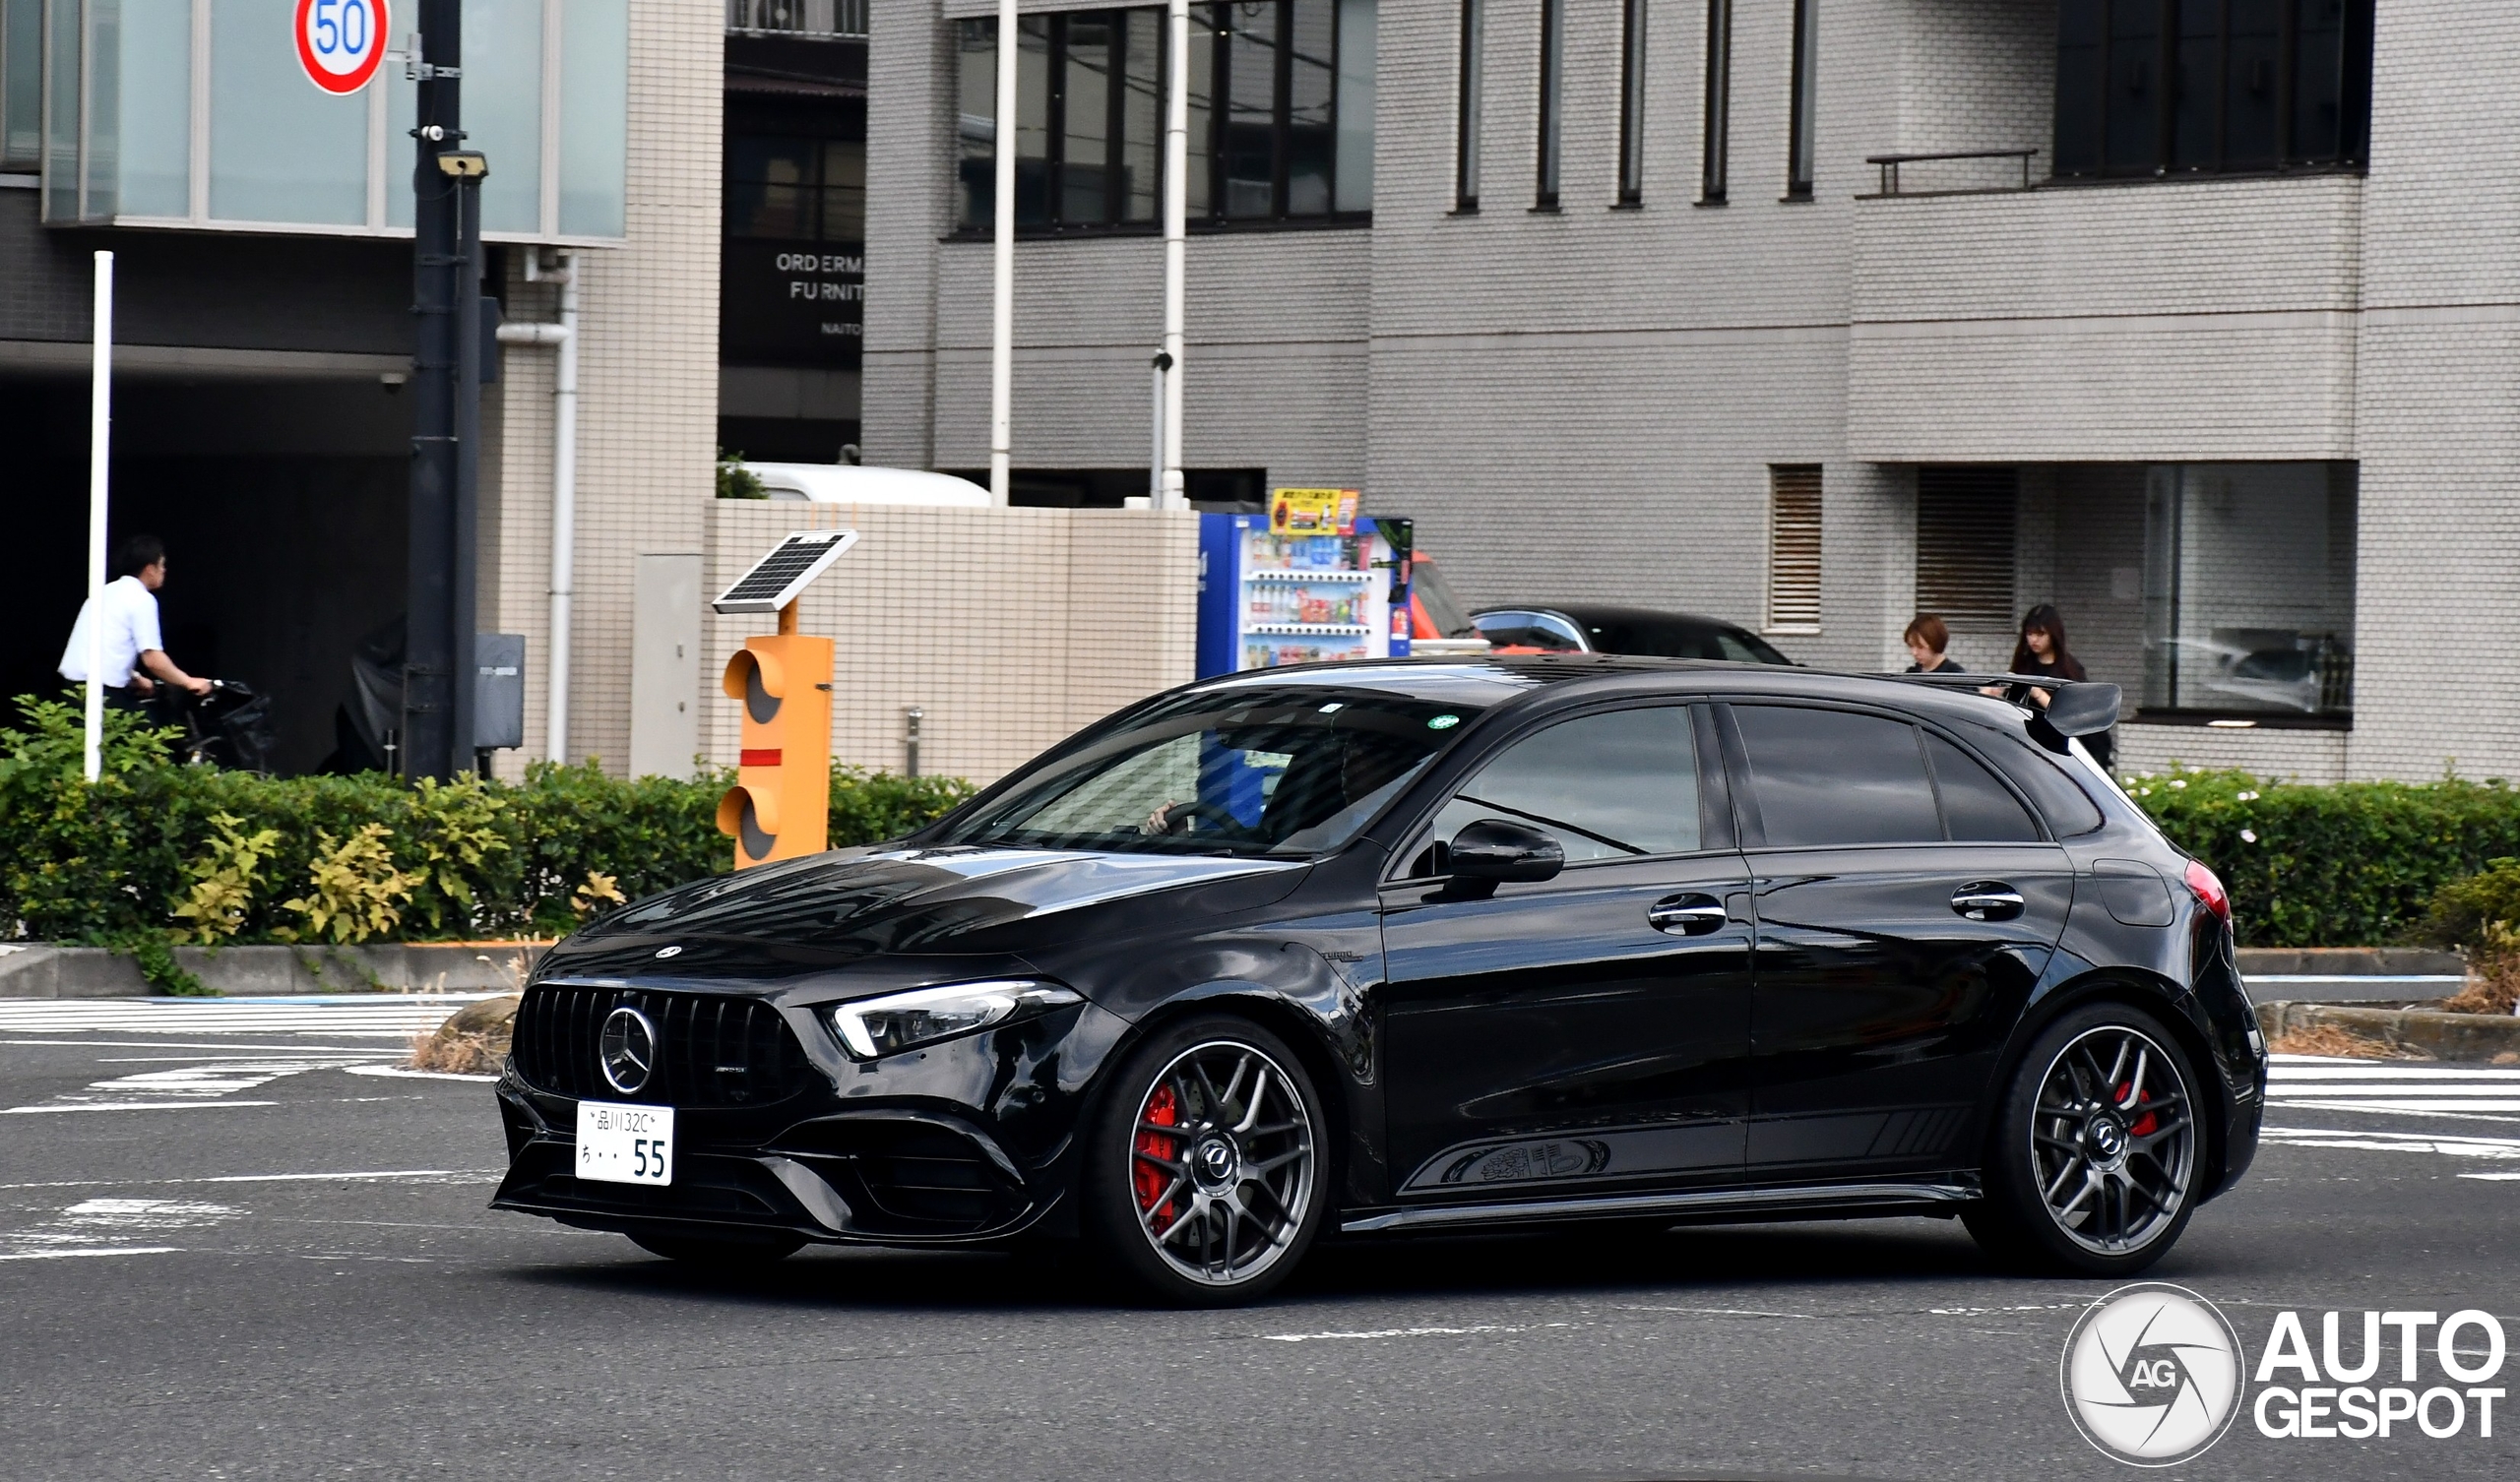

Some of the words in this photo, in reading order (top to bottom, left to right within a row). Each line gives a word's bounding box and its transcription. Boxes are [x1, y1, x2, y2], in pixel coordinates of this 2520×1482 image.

[316, 0, 365, 54] 50
[776, 253, 864, 273] ORDERM
[633, 1139, 665, 1179] 55
